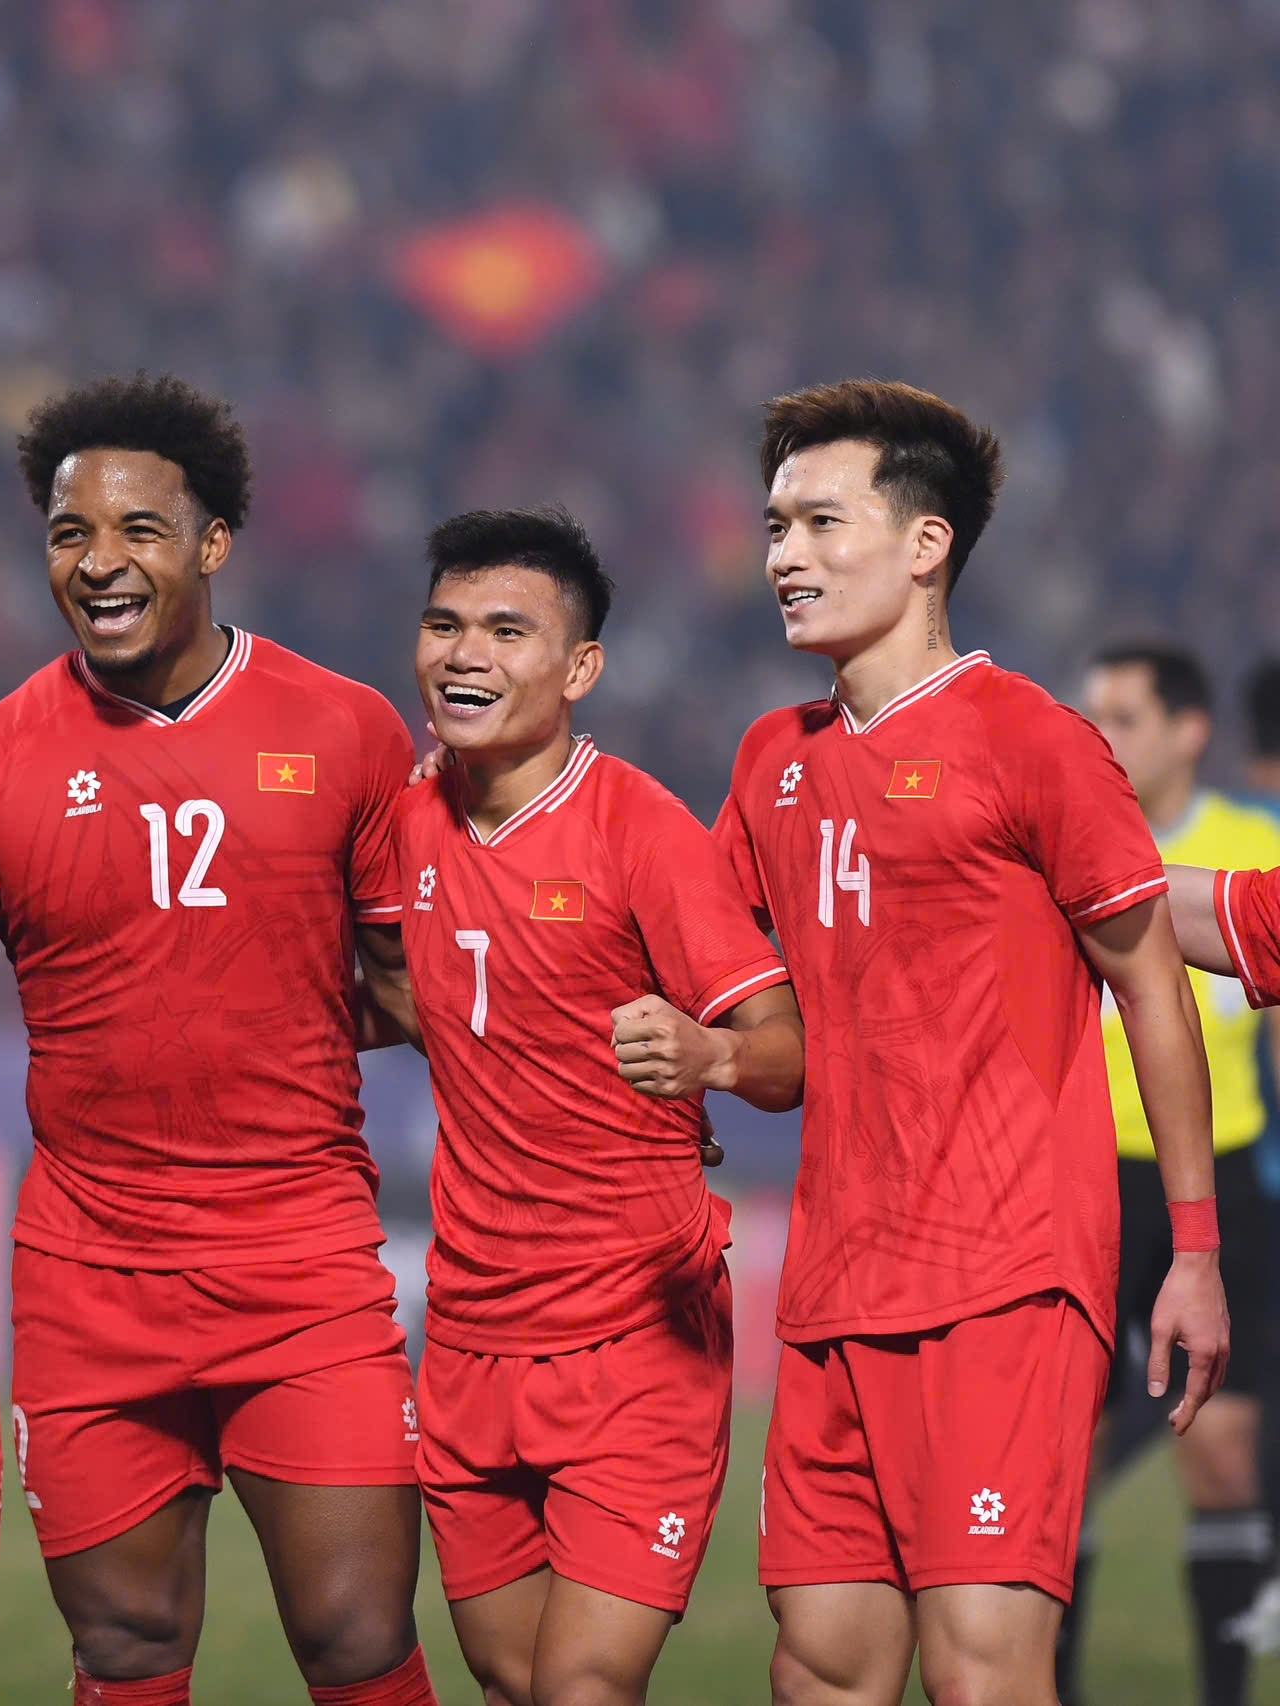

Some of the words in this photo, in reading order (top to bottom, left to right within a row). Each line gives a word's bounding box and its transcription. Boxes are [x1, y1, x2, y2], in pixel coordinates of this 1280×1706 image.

[140, 799, 227, 910] 12
[817, 818, 871, 928] 14
[455, 929, 491, 1037] 7
